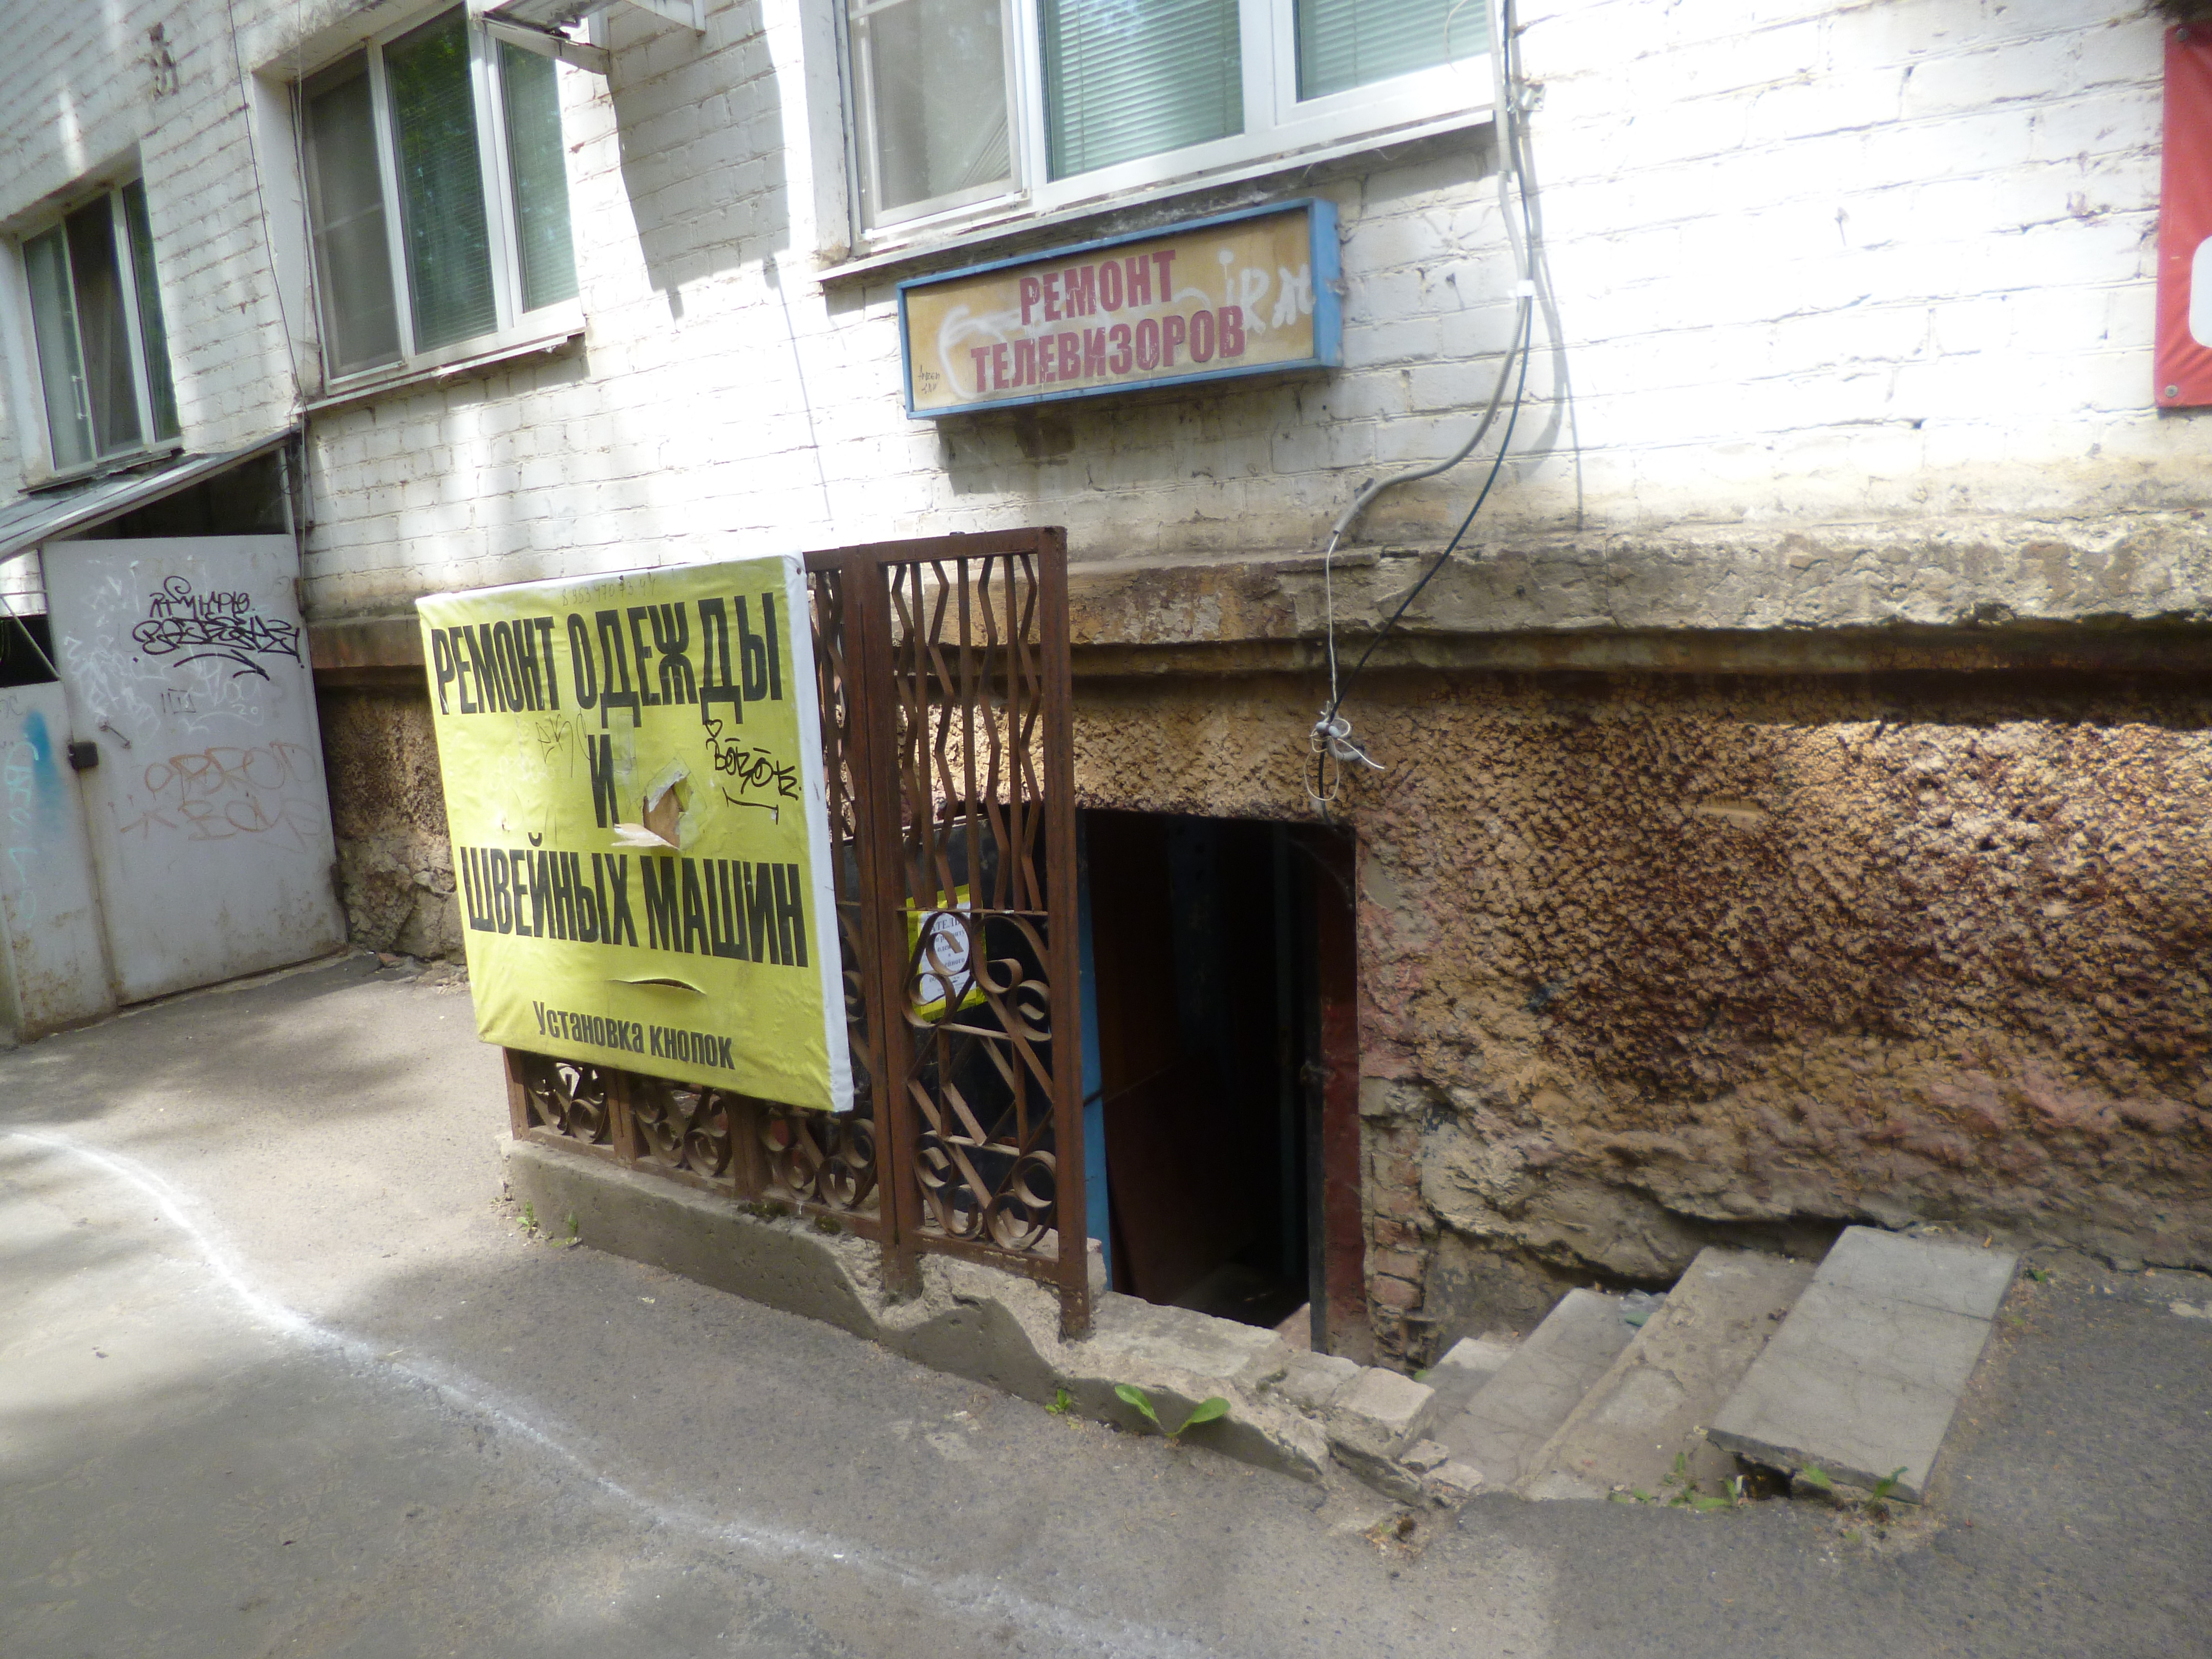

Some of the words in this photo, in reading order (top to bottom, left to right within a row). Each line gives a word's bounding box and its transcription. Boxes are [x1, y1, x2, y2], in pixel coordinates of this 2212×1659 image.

[1019, 249, 1176, 326] РЕМОНТ
[971, 305, 1245, 393] ТЕЛЕВИЗОРОВ
[431, 616, 560, 715] РЕМОНТ
[567, 592, 783, 728] ОДЕЖДЫ
[587, 734, 620, 828] И
[460, 832, 639, 948] ШВЕЙНЫХ
[640, 848, 809, 968] МАШИН
[533, 1001, 645, 1055] Установка
[649, 1025, 736, 1070] кнопок
